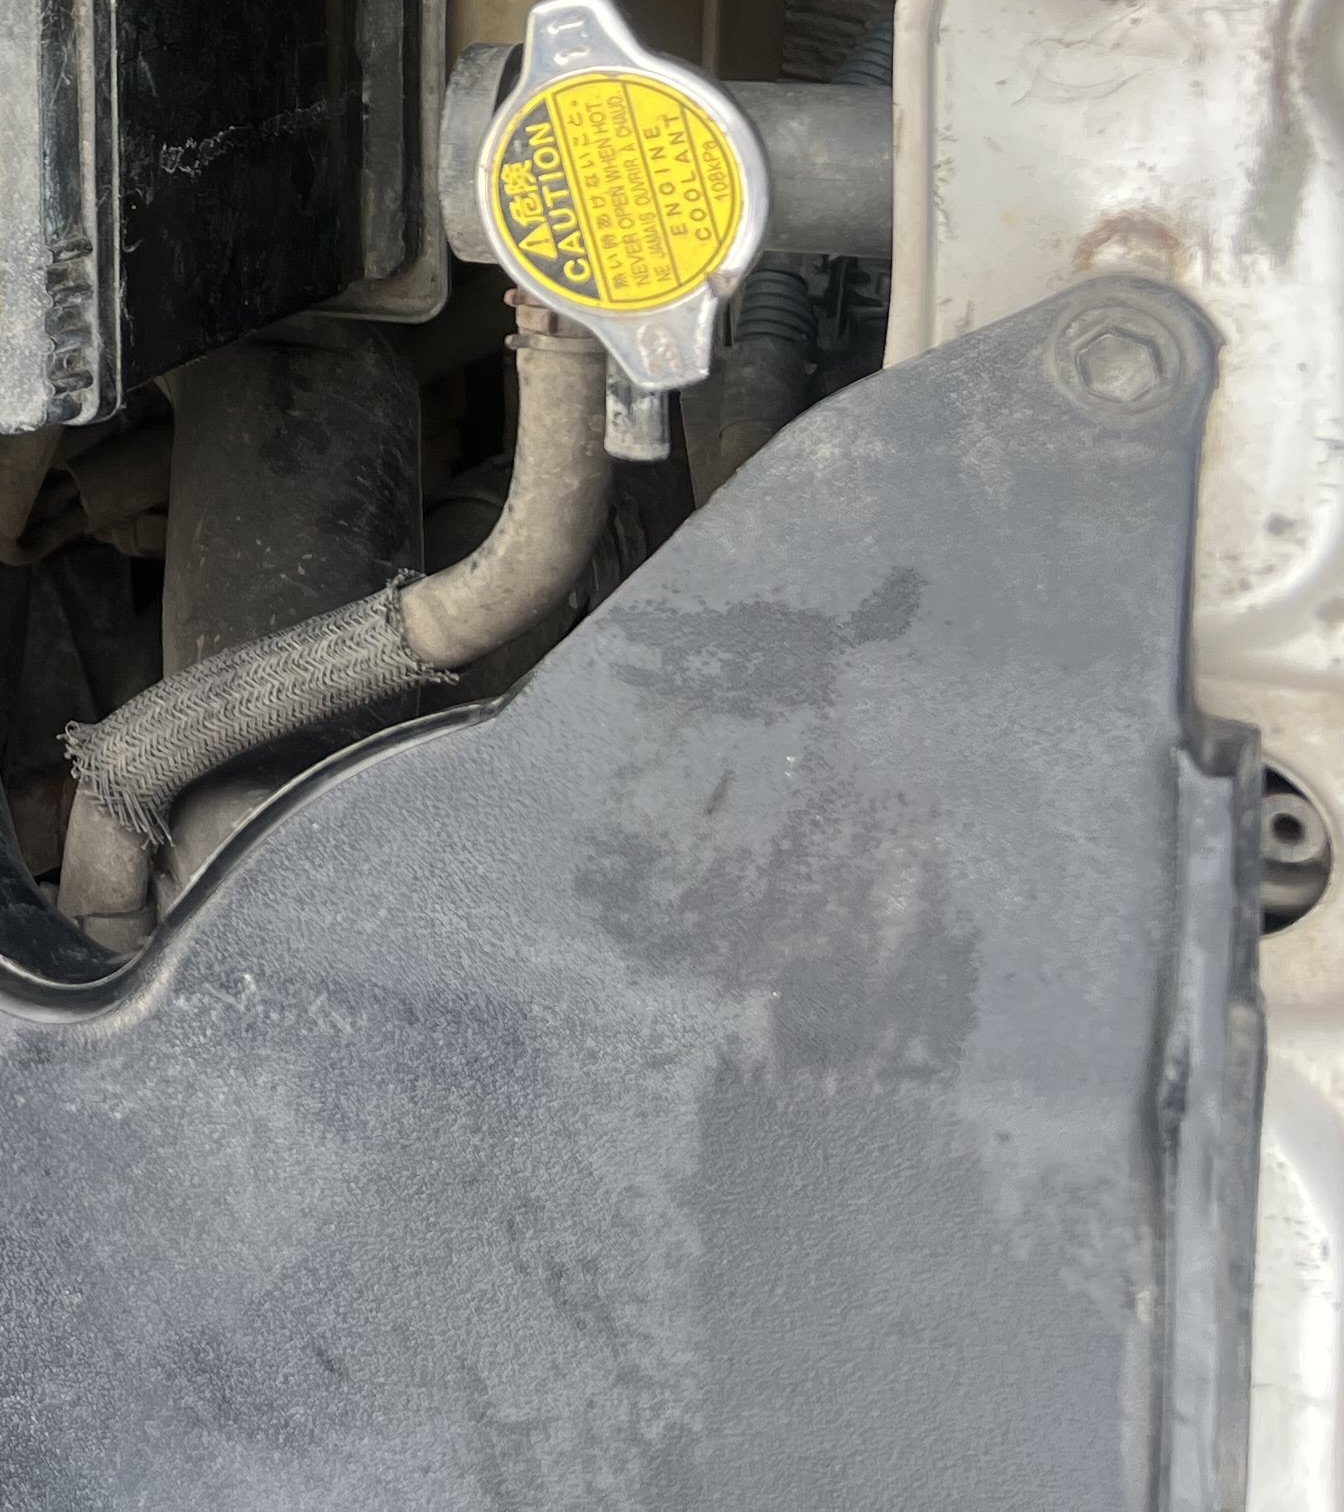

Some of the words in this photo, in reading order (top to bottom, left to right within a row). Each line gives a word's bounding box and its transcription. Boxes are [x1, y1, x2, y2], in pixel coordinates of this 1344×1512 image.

[585, 96, 610, 135] HOT.
[597, 137, 621, 183] WHEN
[623, 159, 651, 207] OUVRIR
[643, 126, 689, 237] ENGINE
[662, 113, 712, 242] COOLANT
[500, 160, 548, 227] 危険
[525, 122, 592, 283] CAUTION
[611, 185, 635, 229] OPEN
[638, 211, 666, 259] JAMAIS
[621, 232, 650, 287] NEVER
[653, 266, 671, 284] NE
